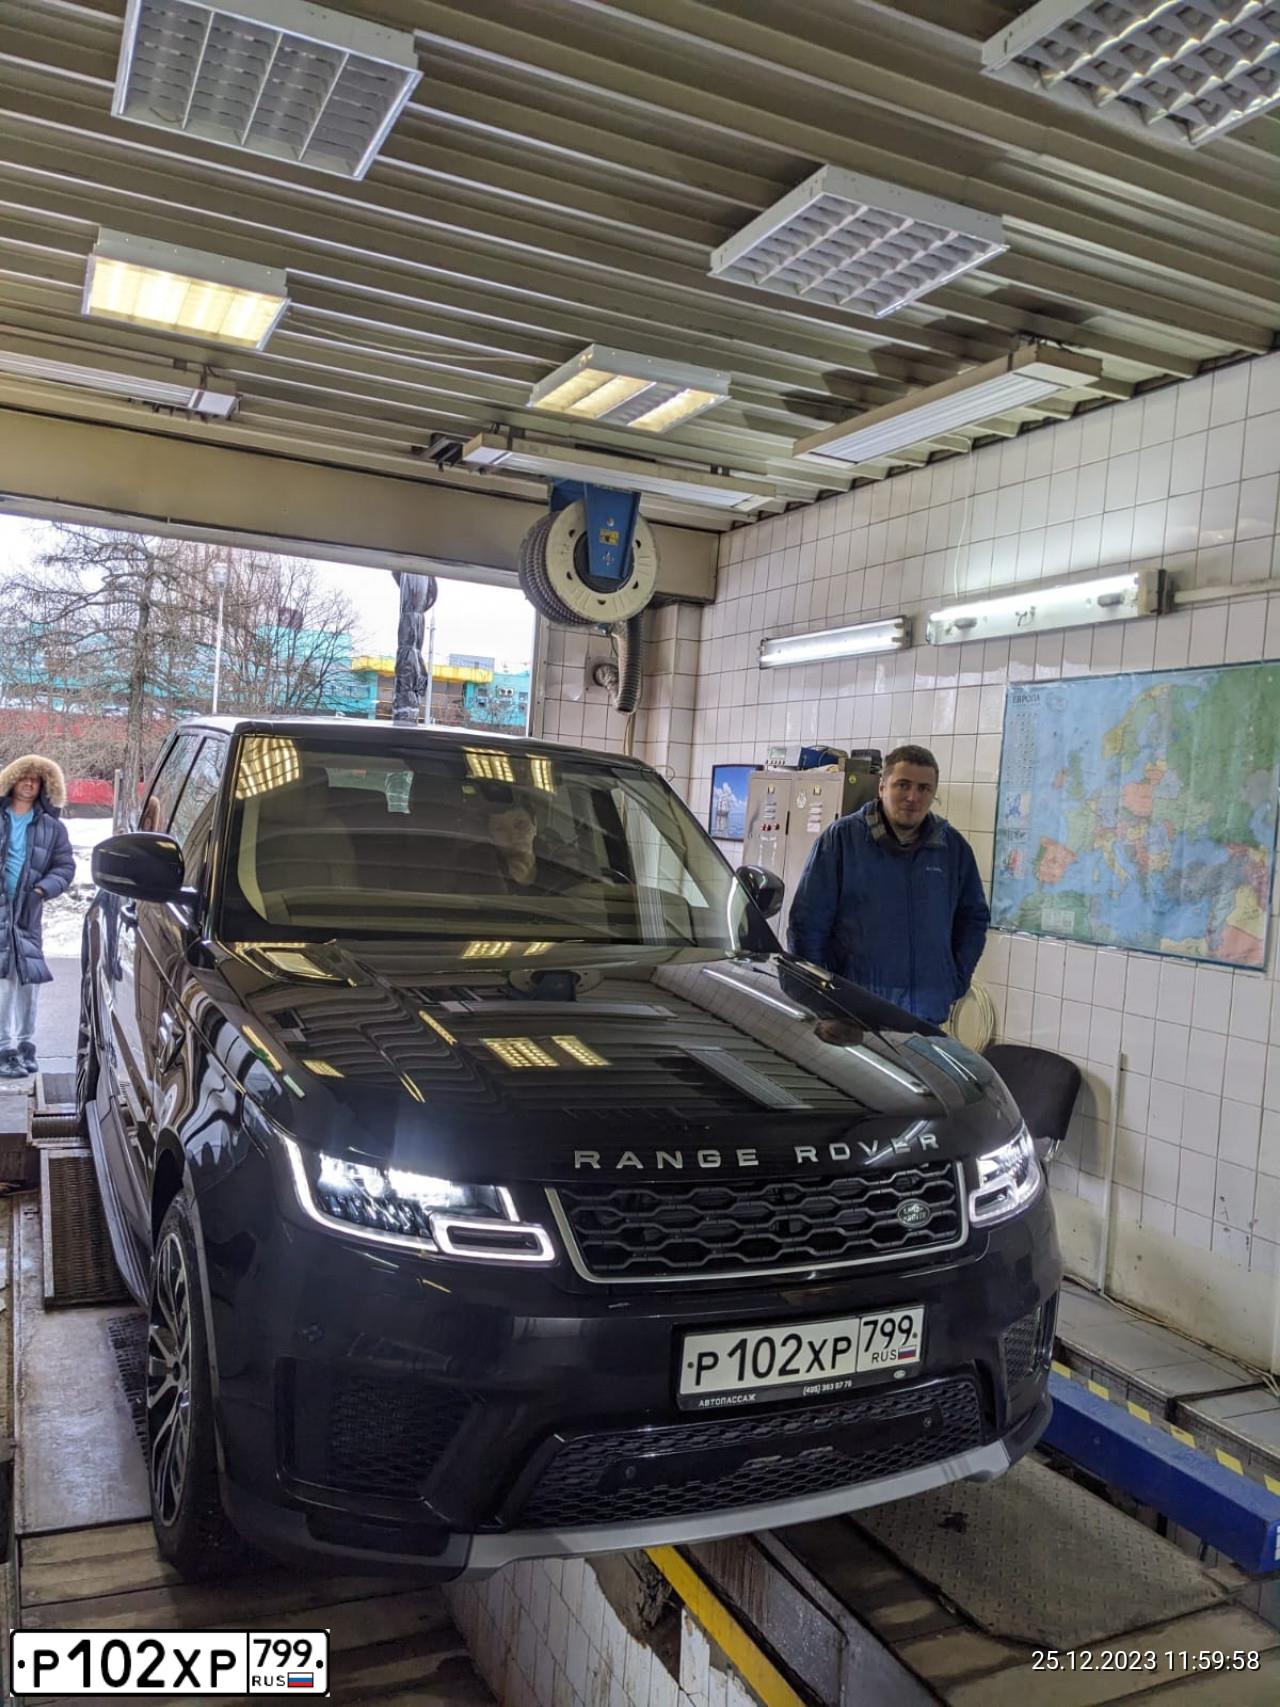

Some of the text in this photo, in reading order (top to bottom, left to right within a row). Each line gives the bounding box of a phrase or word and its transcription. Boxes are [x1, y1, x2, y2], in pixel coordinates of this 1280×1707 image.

[574, 1133, 940, 1169] RANGE ROVER
[862, 1314, 914, 1352] 799
[871, 1349, 897, 1364] RUS
[698, 1393, 757, 1408] АВТОПАССАЖ
